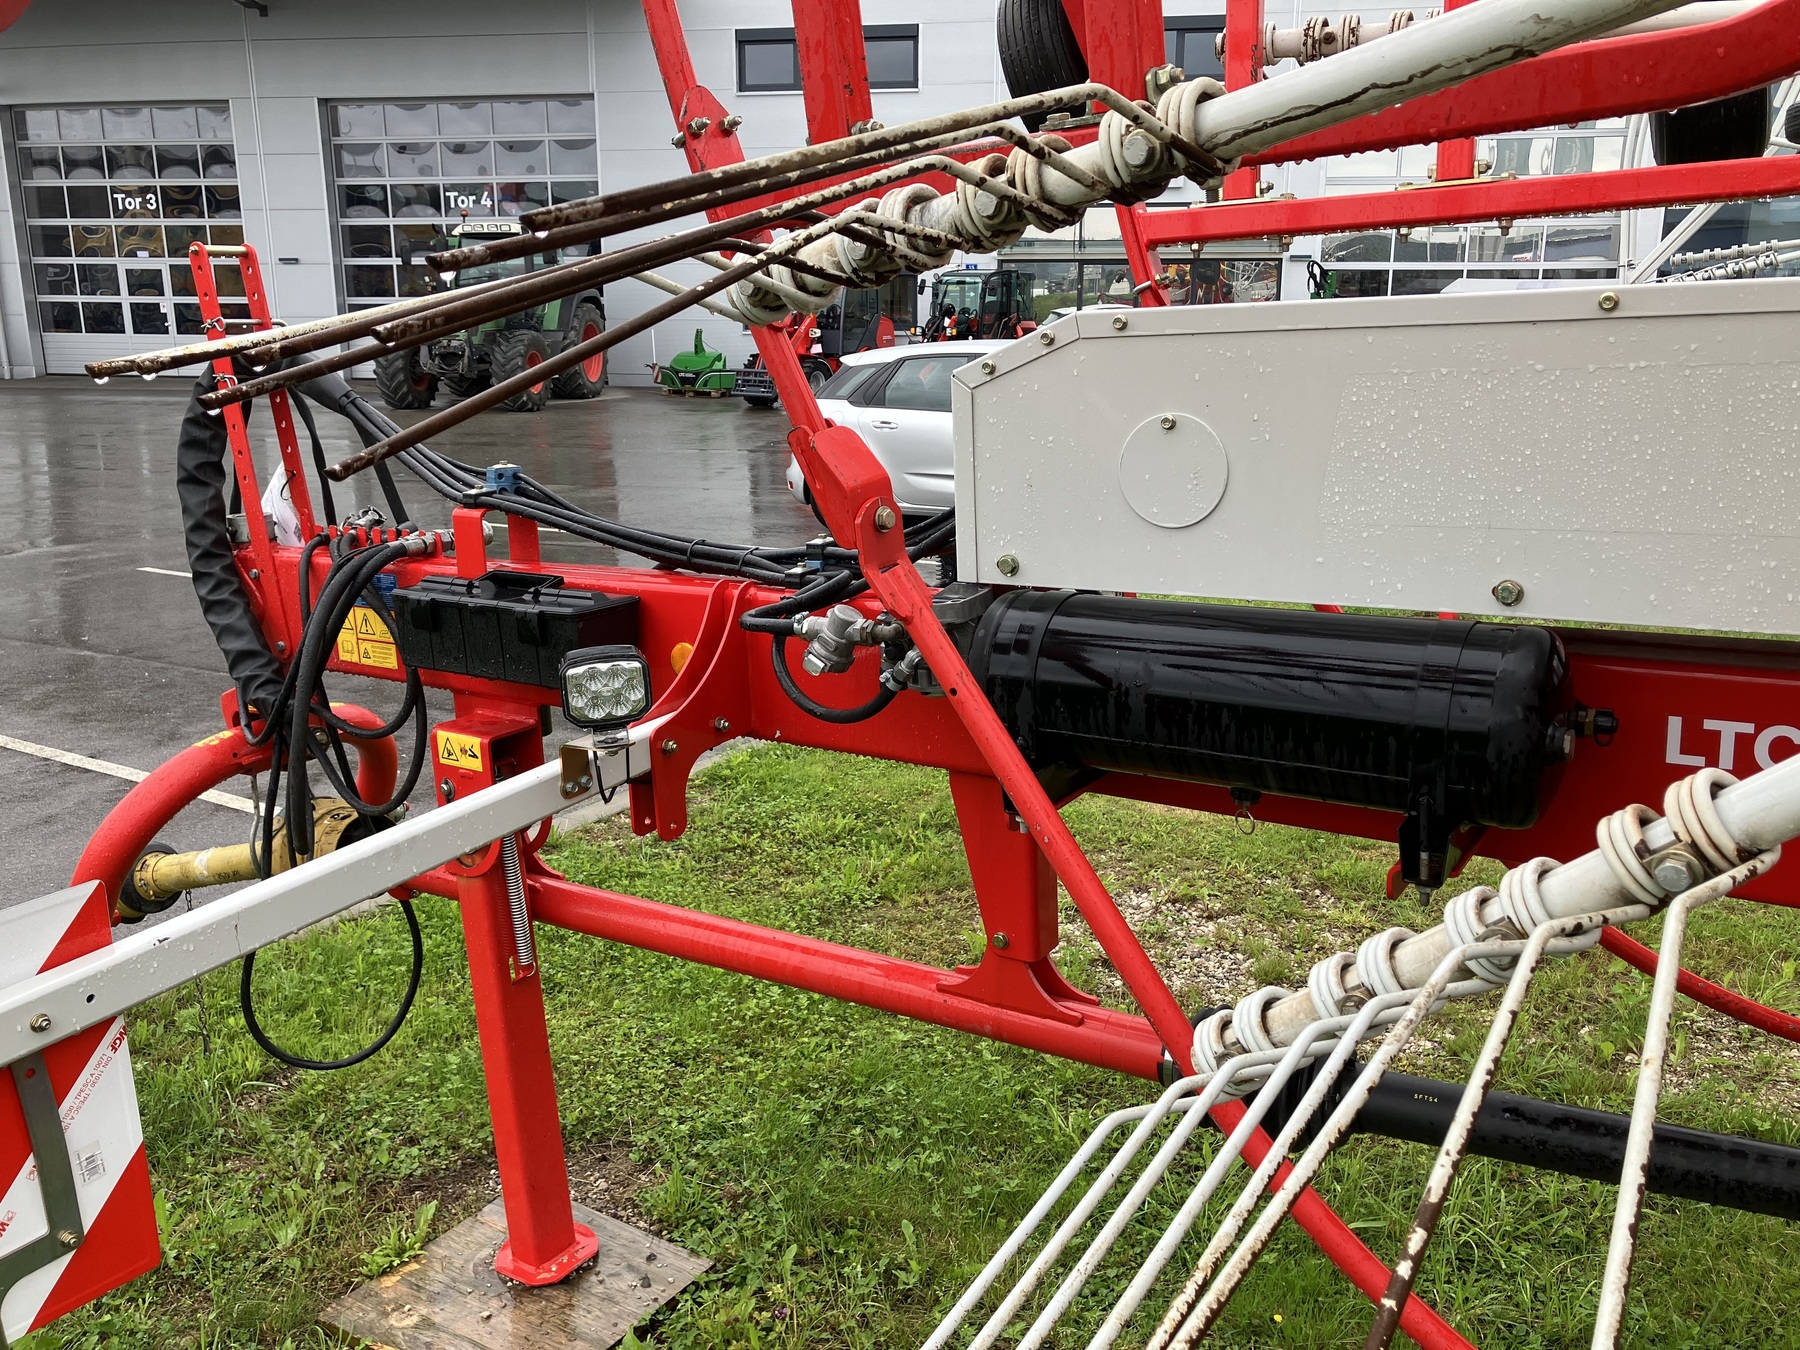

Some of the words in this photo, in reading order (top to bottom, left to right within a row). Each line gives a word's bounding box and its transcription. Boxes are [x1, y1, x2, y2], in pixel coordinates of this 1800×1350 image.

[113, 193, 142, 210] Tor
[146, 193, 157, 210] 3
[445, 191, 477, 209] Tor
[480, 191, 493, 208] 4
[1665, 715, 1800, 771] LTC
[102, 1056, 113, 1068] DIN
